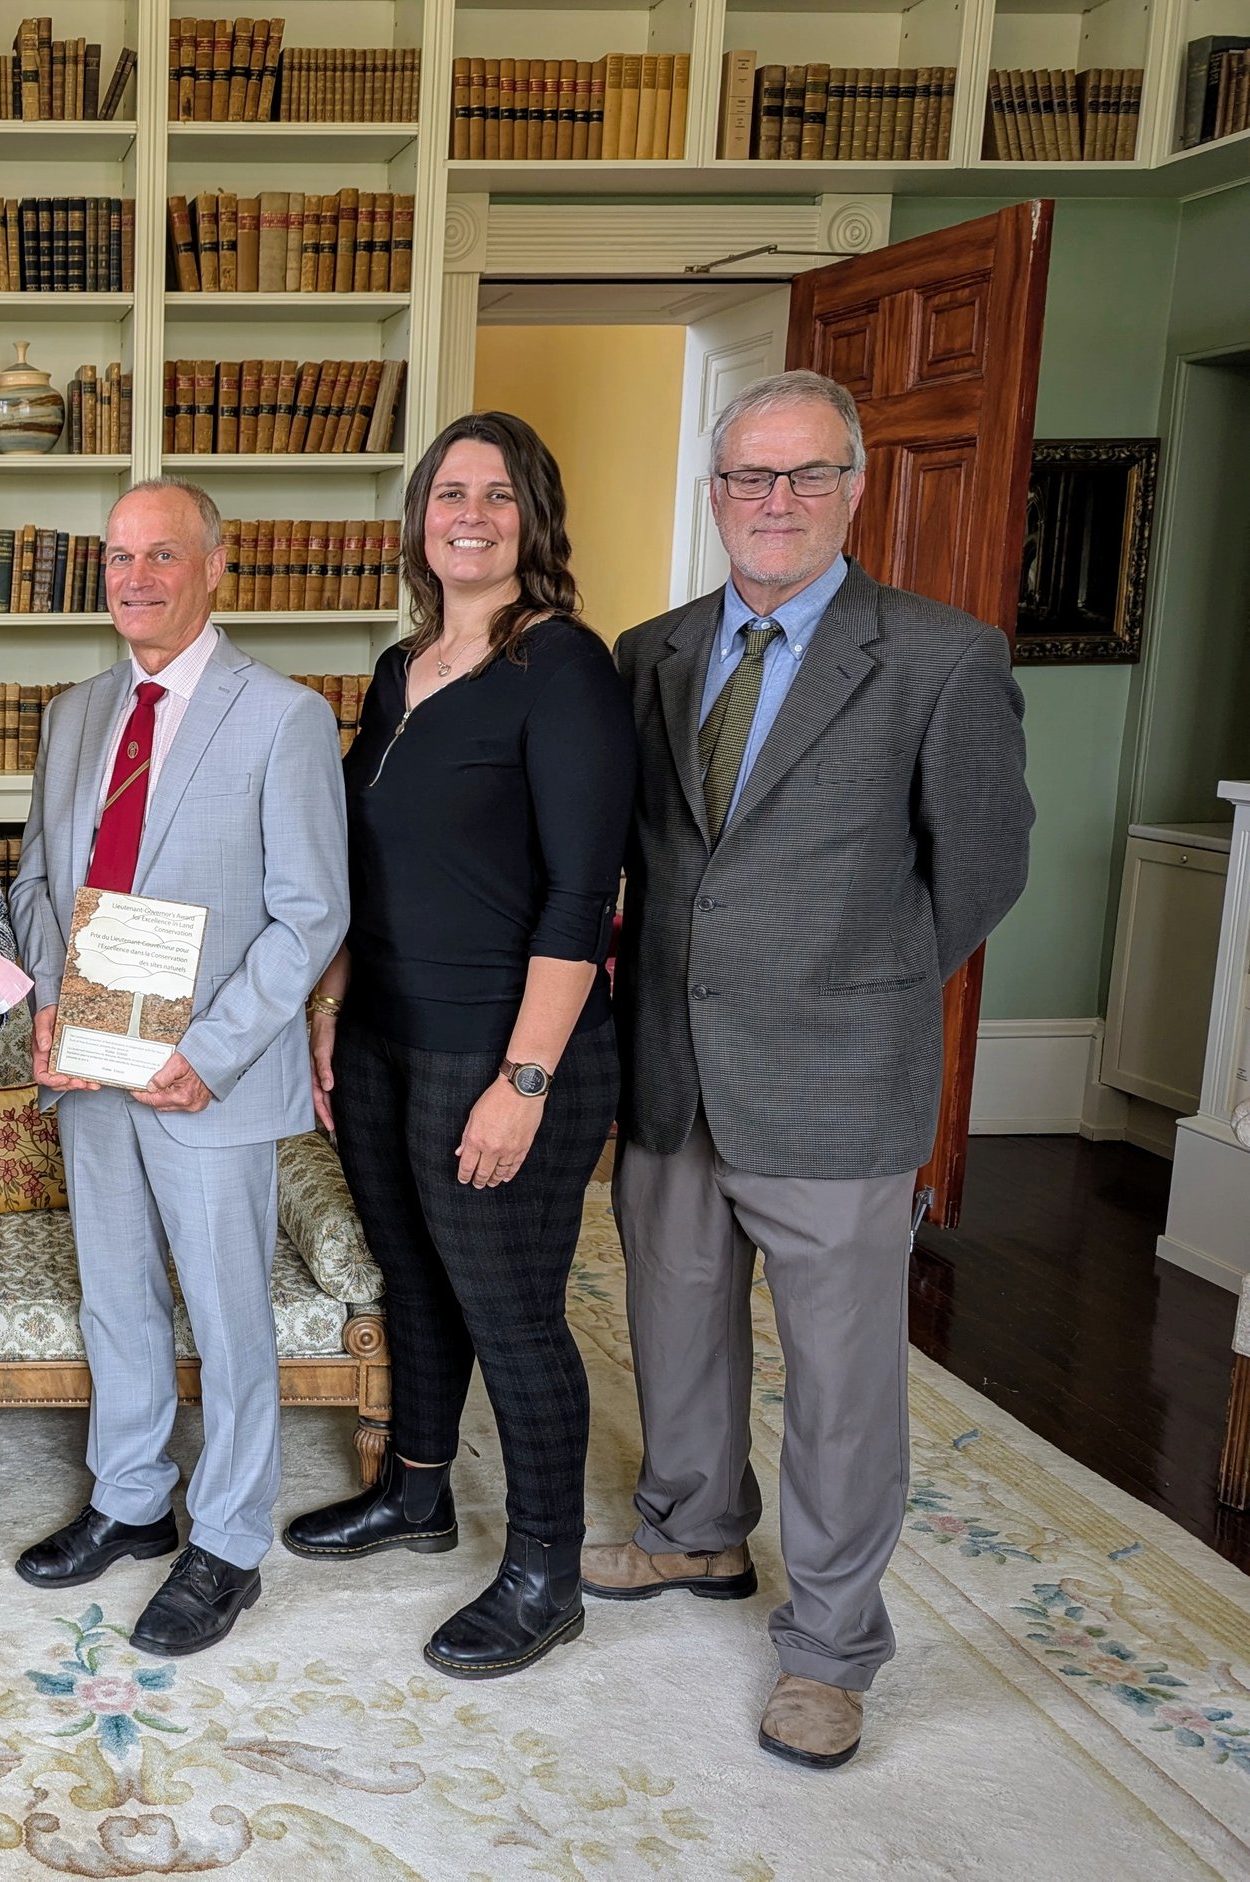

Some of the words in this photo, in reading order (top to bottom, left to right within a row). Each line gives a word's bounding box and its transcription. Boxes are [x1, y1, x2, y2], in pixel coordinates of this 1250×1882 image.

[112, 903, 175, 918] Lieutenant-Governor's
[142, 915, 171, 925] Excellence
[179, 921, 194, 929] Land
[154, 926, 192, 937] Conservation
[151, 952, 188, 963] Conservation
[163, 963, 186, 973] naturels
